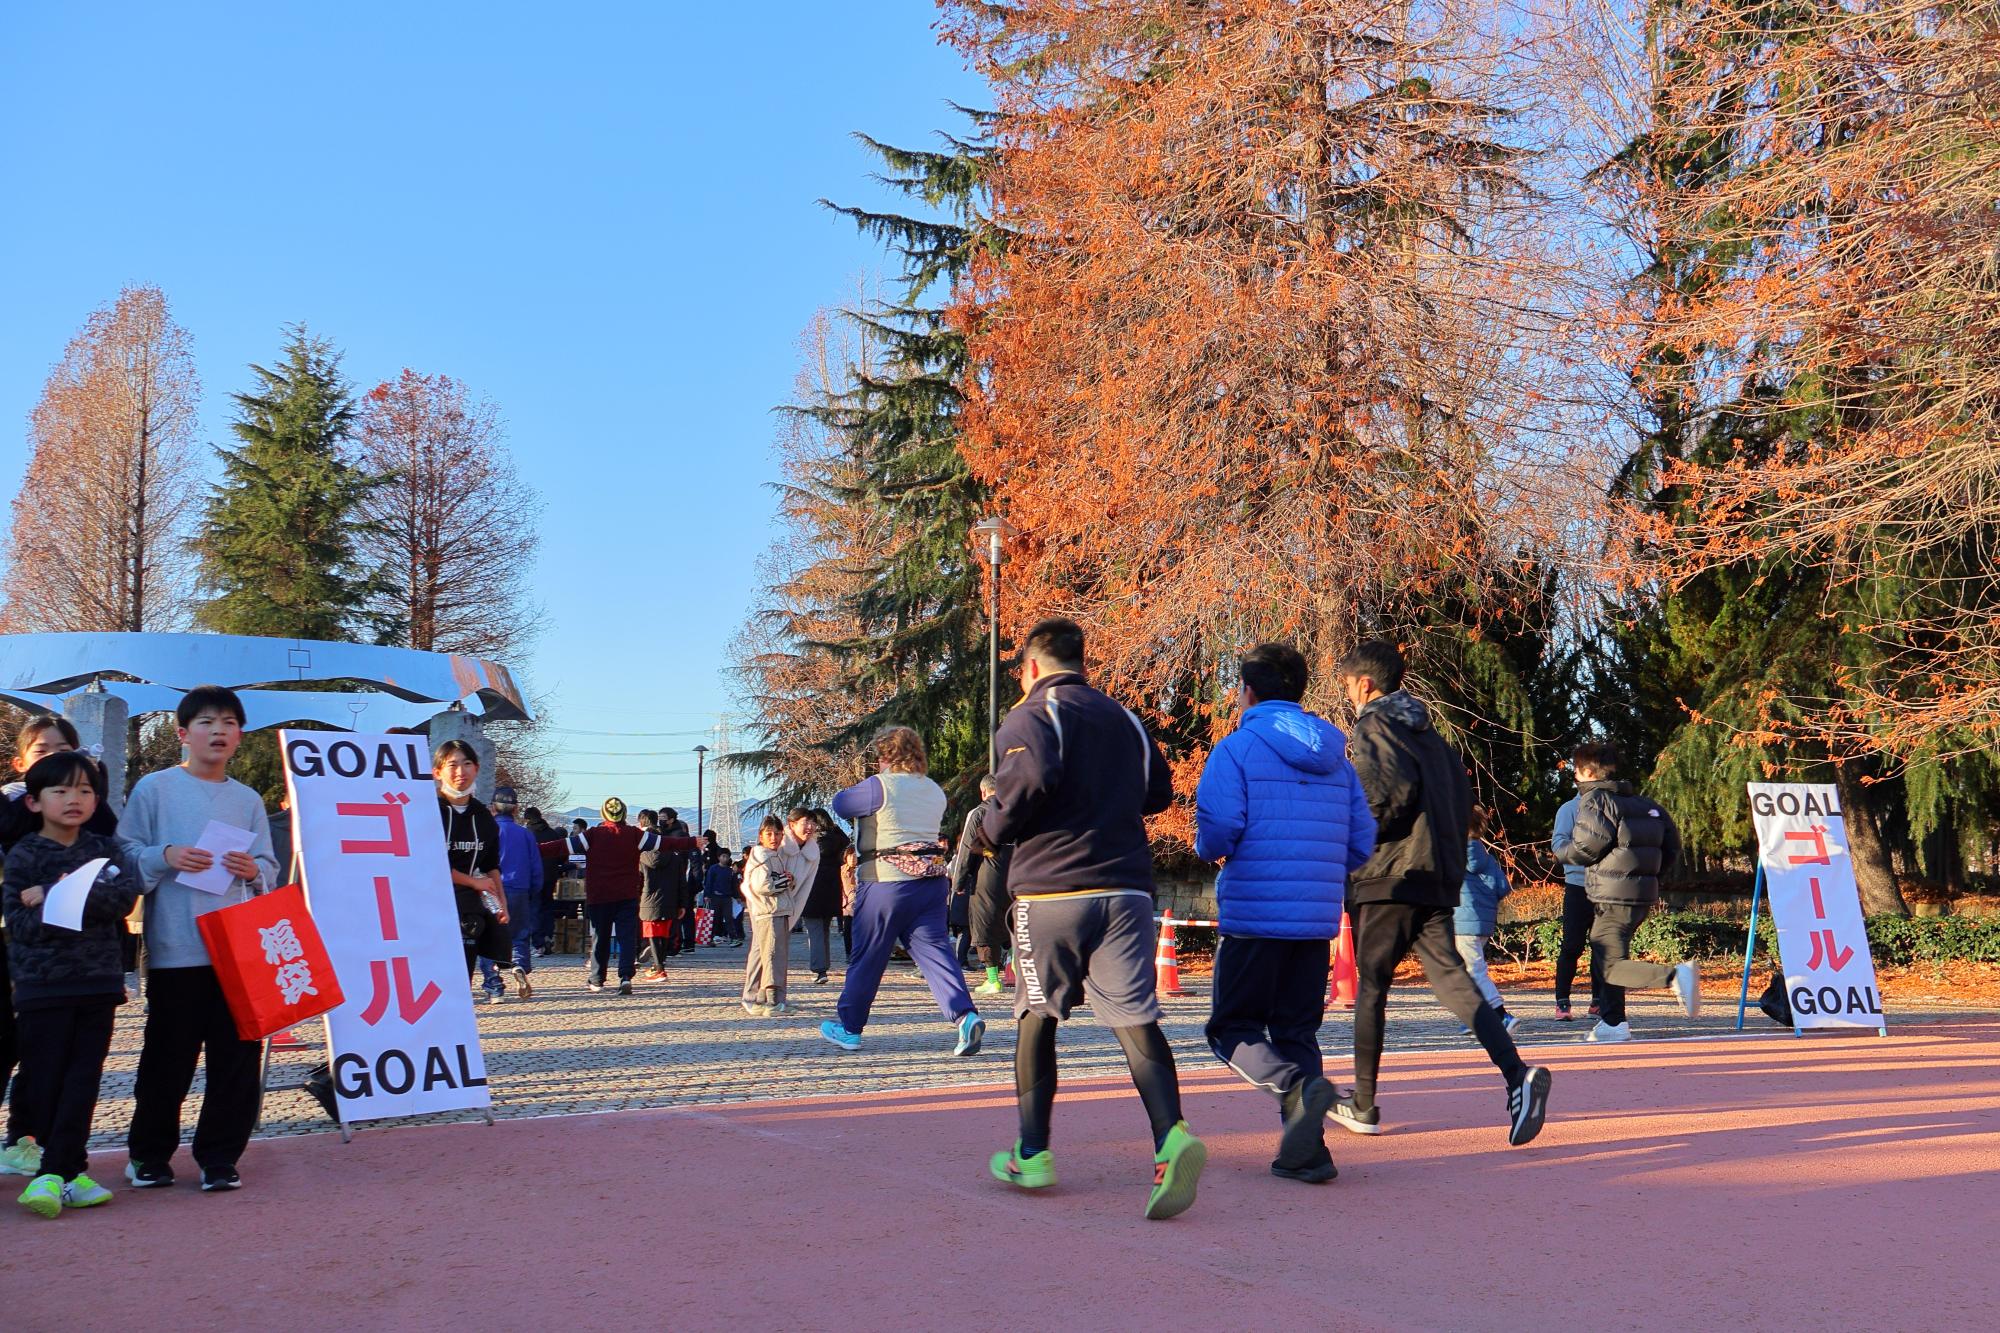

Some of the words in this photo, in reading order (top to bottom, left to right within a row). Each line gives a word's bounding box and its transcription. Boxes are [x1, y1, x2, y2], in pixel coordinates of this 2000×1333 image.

[286, 739, 434, 781] GOAL
[1752, 792, 1843, 817] GOAL
[336, 791, 443, 1027] ゴール
[1016, 898, 1032, 952] ARMOU
[1784, 824, 1854, 973] ゴール
[258, 918, 318, 1005] 福袋
[1020, 957, 1047, 1005] UNDER
[1791, 986, 1883, 1015] GOAL
[333, 1044, 487, 1099] GOAL
